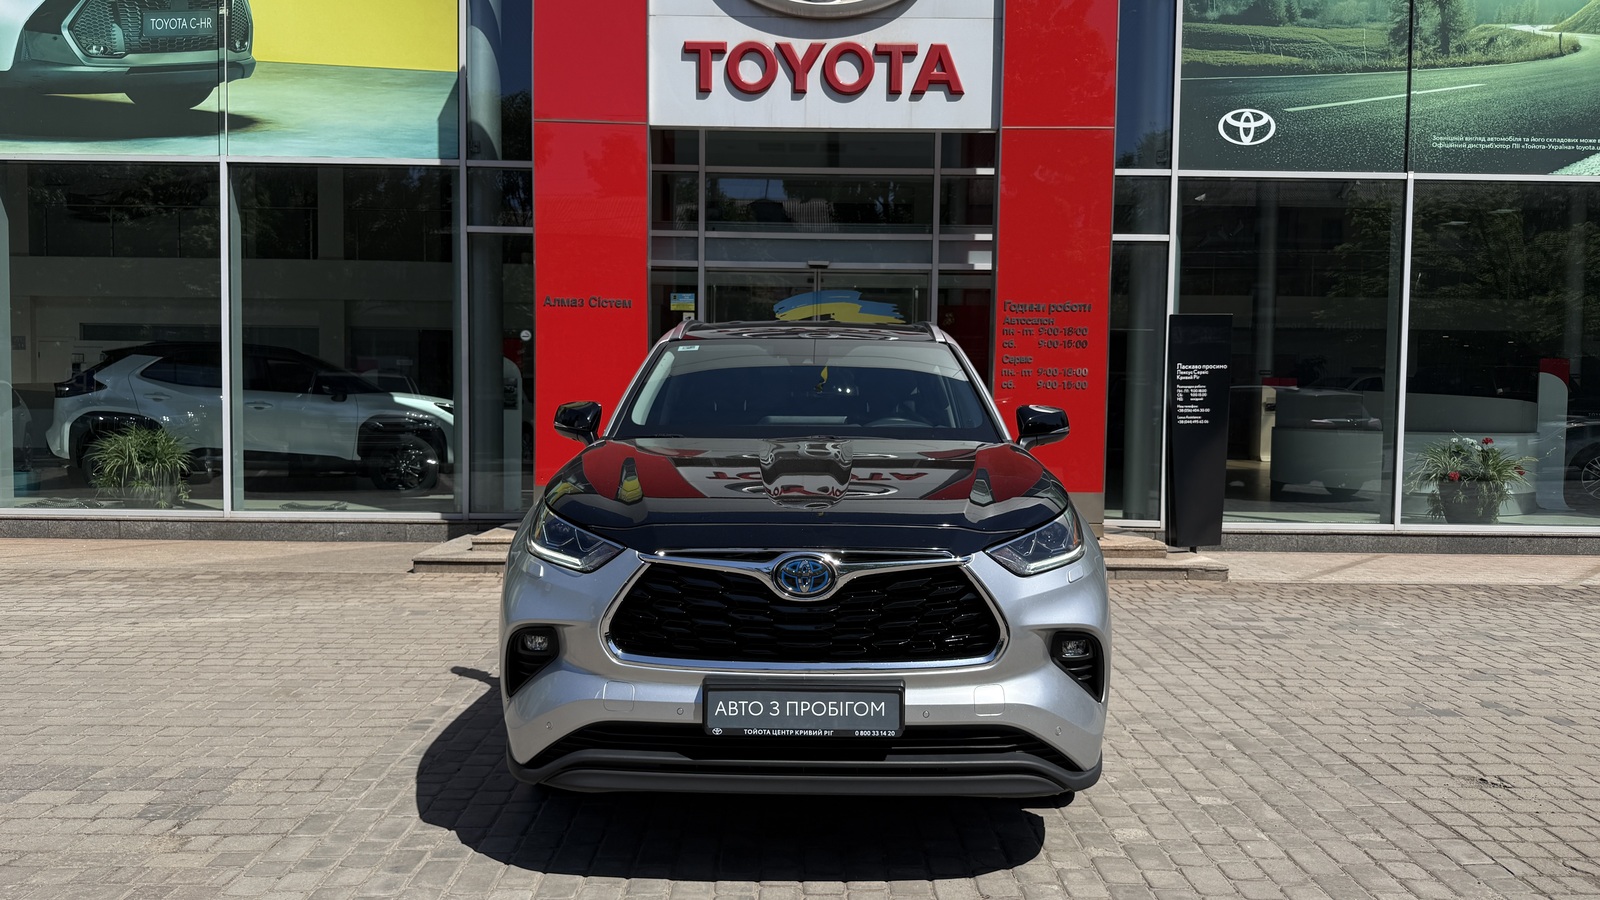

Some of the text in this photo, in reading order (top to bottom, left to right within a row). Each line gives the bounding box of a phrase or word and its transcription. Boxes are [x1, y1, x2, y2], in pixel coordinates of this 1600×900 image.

[150, 17, 213, 30] TOYOTA C-HR
[684, 41, 965, 96] TOYOTA
[543, 296, 632, 309] Алмаз Сістем
[1003, 300, 1092, 315] Години роботи
[1003, 316, 1055, 325] Автосалон
[1038, 327, 1089, 336] 9:00-18:00
[1002, 354, 1033, 365] Сервіс
[715, 701, 885, 717] АВТО З ПРОБІГОМ
